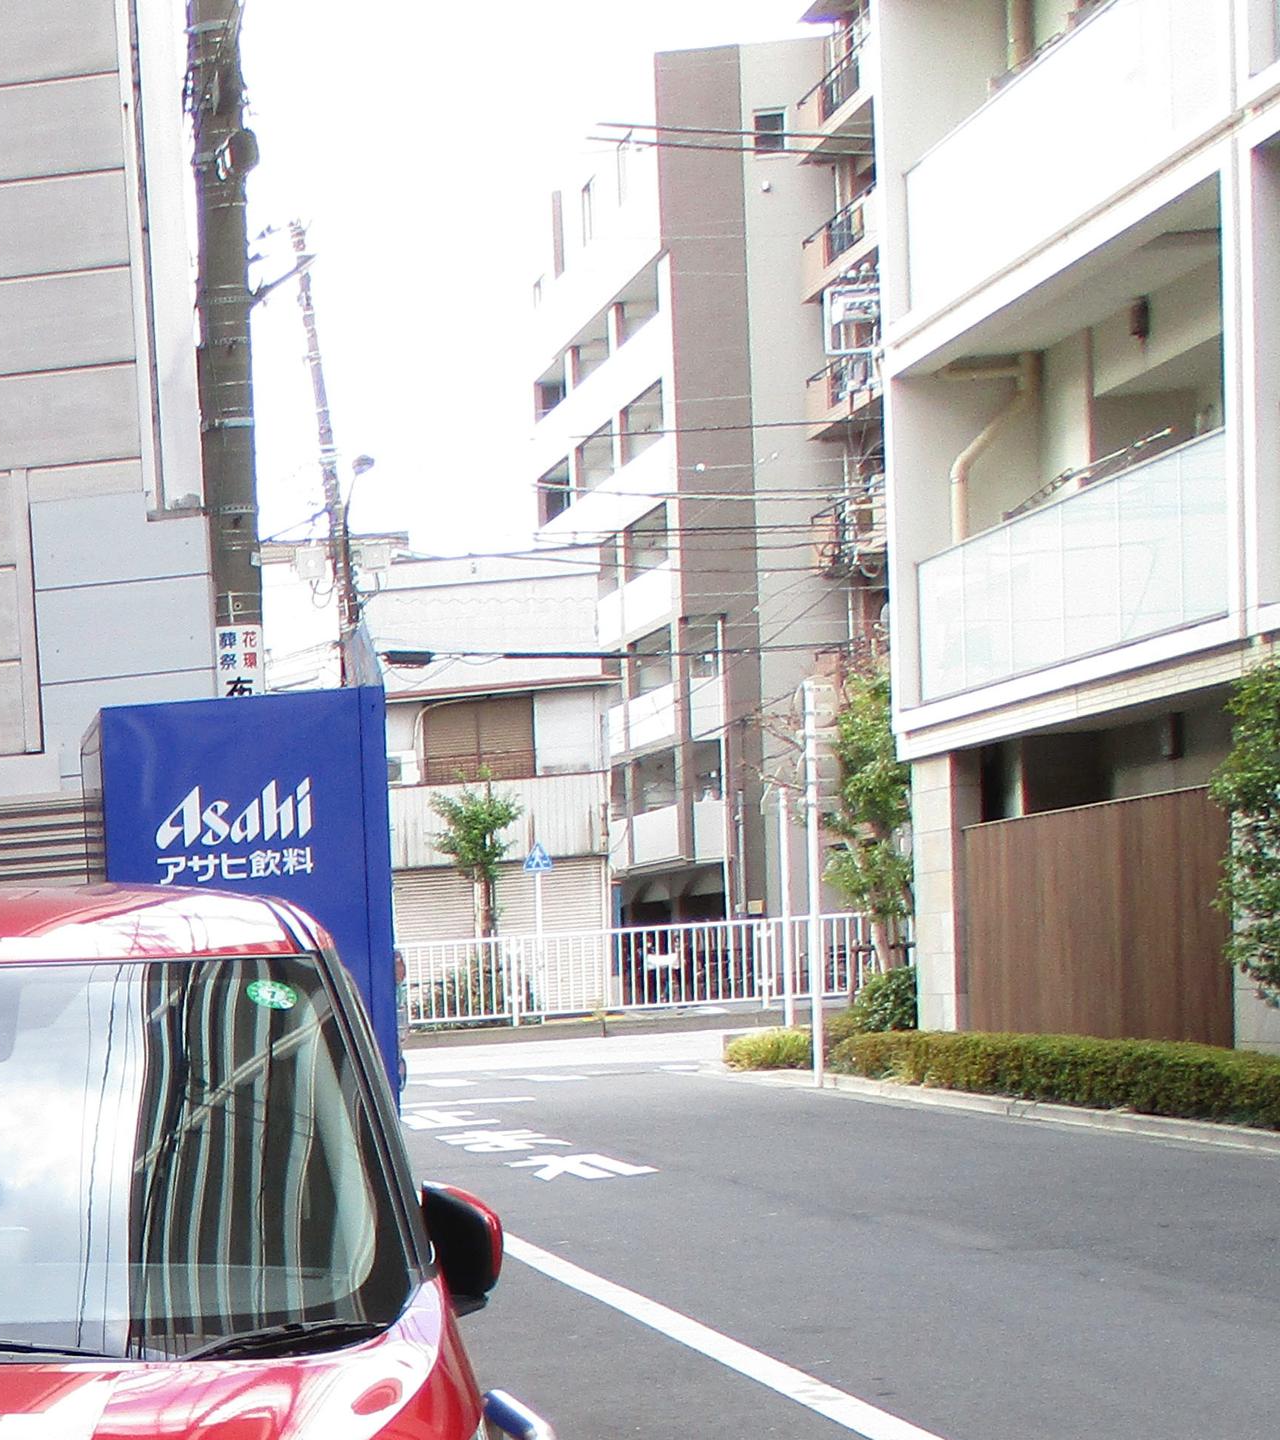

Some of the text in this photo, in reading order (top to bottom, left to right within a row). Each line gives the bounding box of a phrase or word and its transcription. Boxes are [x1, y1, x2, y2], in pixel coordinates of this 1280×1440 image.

[219, 631, 237, 670] 葬祭
[242, 630, 258, 669] 花環
[156, 777, 312, 850] Asahi
[157, 847, 314, 885] アサヒ飲料
[400, 1110, 659, 1181] 止まれ
